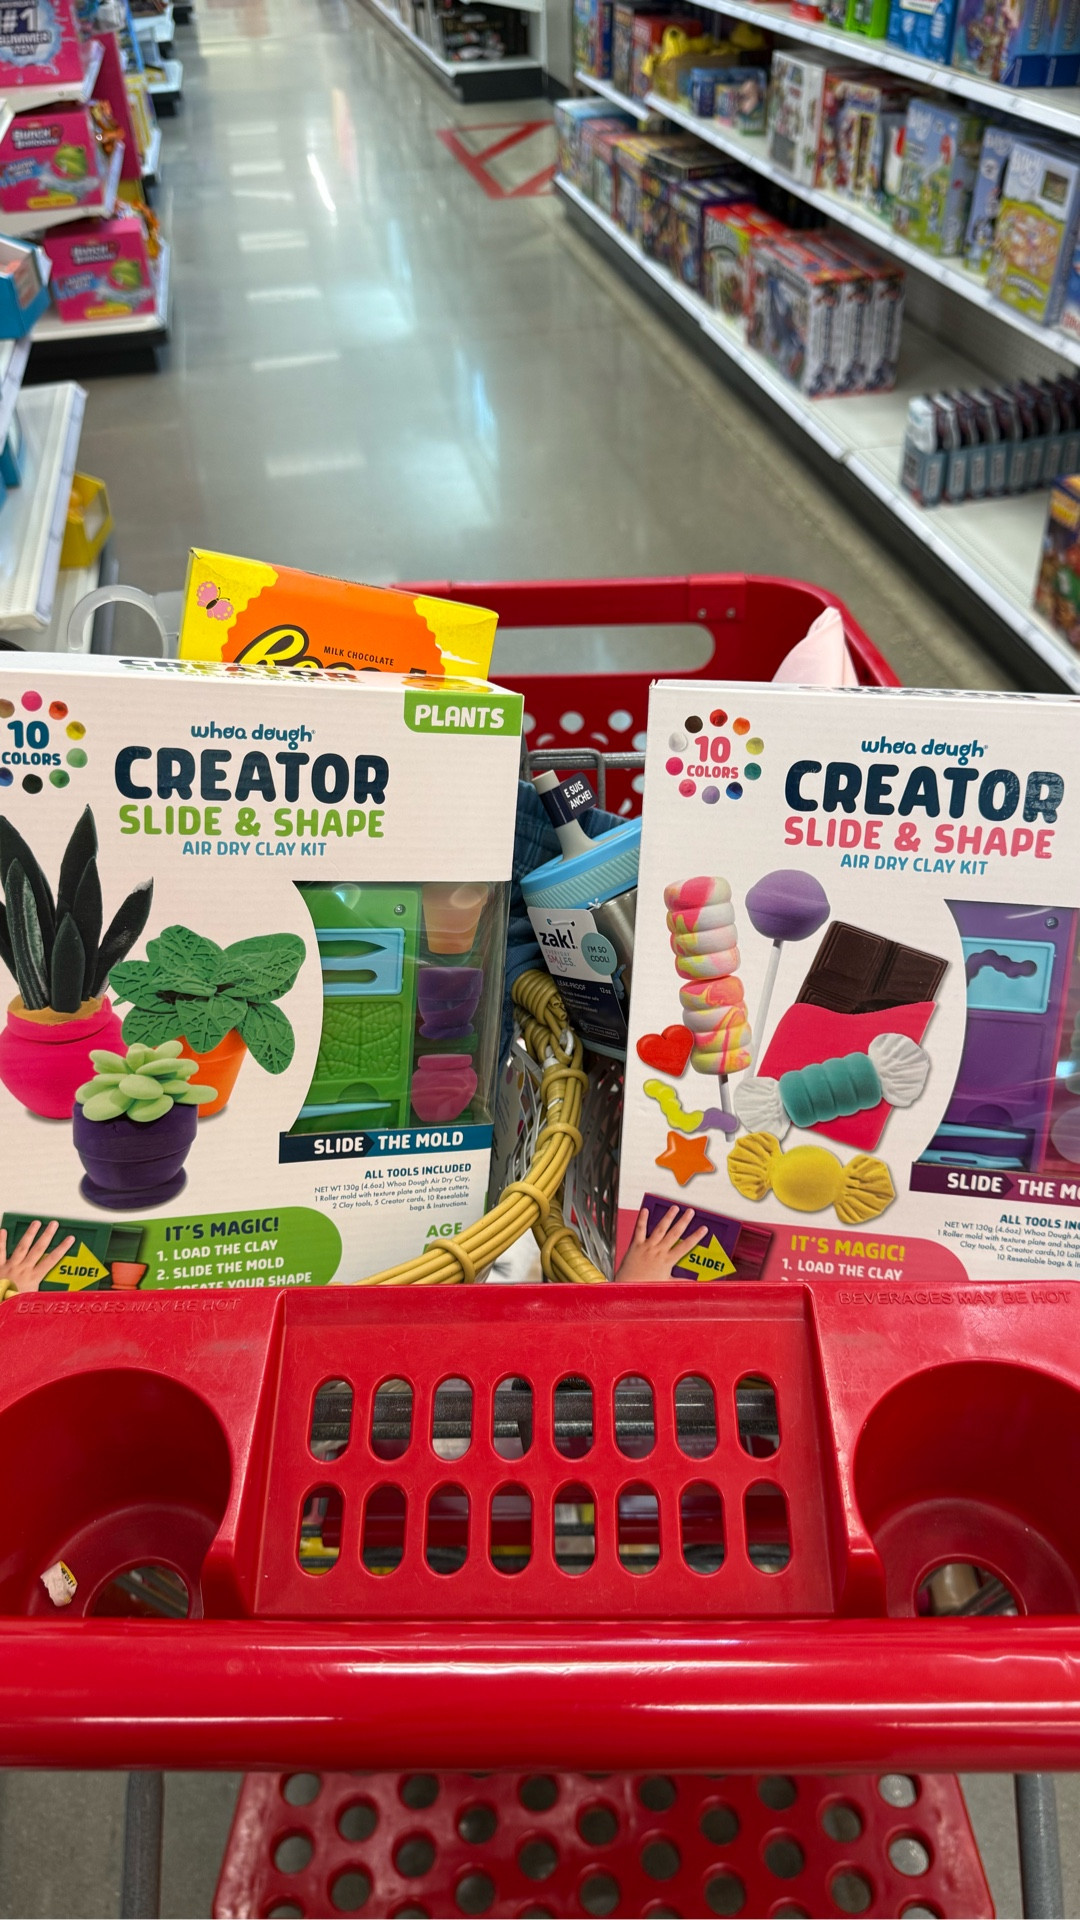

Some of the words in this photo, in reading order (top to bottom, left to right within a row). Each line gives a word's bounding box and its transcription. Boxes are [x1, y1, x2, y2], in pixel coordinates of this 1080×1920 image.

[323, 645, 344, 657] MILK
[347, 650, 395, 666] CHOCOLATE
[414, 704, 505, 729] PLANTS
[8, 720, 50, 749] 10
[191, 721, 247, 740] whoa
[694, 736, 731, 763] 10
[861, 736, 917, 755] whoa
[2, 752, 61, 766] COLORS
[115, 746, 389, 804] CREATOR
[687, 765, 739, 779] COLORS
[569, 780, 584, 795] SUIS
[784, 760, 1065, 823] CREATOR
[568, 790, 593, 810] ANCHE!
[119, 804, 222, 836] SLIDE
[235, 807, 261, 837] &
[274, 807, 385, 839] SHAPE
[784, 816, 884, 850] SLIDE
[894, 822, 921, 852] &
[934, 824, 1056, 859] SHAPE
[182, 841, 212, 855] AIR
[217, 841, 251, 856] DRY
[255, 842, 296, 856] CLAY
[301, 842, 327, 856] KIT
[840, 854, 870, 869] AIR
[874, 855, 909, 871] DRY
[913, 857, 955, 874] CLAY
[960, 860, 988, 875] KIT
[539, 929, 573, 949] zak!
[587, 945, 597, 953] I'M
[598, 946, 607, 954] SO
[314, 1137, 364, 1155] SLIDE
[378, 1134, 411, 1150] THE
[416, 1131, 463, 1148] MOLD
[365, 1169, 383, 1179] ALL
[387, 1167, 419, 1178] TOOLS
[422, 1163, 471, 1175] INCLUDED
[361, 1182, 385, 1190] (4.6oz)
[408, 1178, 428, 1187] Dough
[454, 1175, 470, 1183] Clay,
[373, 1190, 395, 1198] texture
[397, 1188, 413, 1196] plate
[415, 1186, 427, 1194] and
[429, 1186, 447, 1194] shape
[947, 1172, 1003, 1193] SLIDE
[1017, 1179, 1056, 1197] THE
[1060, 1183, 1080, 1200] M
[339, 1201, 354, 1210] Clay
[381, 1197, 405, 1205] Creator
[407, 1195, 425, 1203] cards,
[436, 1192, 469, 1200] Resealable
[409, 1204, 425, 1212] bags
[165, 1223, 204, 1242] IT'S
[210, 1217, 279, 1237] MAGIC!
[426, 1222, 462, 1238] AGE
[1000, 1214, 1021, 1225] ALL
[1025, 1216, 1061, 1229] TOOLS
[943, 1230, 963, 1238] Roller
[1001, 1236, 1026, 1244] texture
[976, 1224, 993, 1232] 130g
[995, 1226, 1021, 1235] (4.6oz)
[1024, 1228, 1046, 1237] Whoa
[1048, 1231, 1071, 1240] Dough
[156, 1251, 168, 1262] 1.
[173, 1246, 210, 1260] LOAD
[214, 1243, 241, 1256] THE
[244, 1239, 278, 1252] CLAY
[791, 1235, 829, 1254] IT'S
[834, 1239, 905, 1261] MAGIC!
[960, 1240, 976, 1249] Clay
[978, 1243, 997, 1251] tools,
[1006, 1245, 1033, 1254] Creator
[156, 1269, 169, 1280] 2.
[173, 1264, 212, 1279] SLIDE
[216, 1261, 242, 1274] THE
[246, 1257, 284, 1271] MOLD
[689, 1253, 725, 1272] SLIDE!
[782, 1258, 792, 1270] 1.
[797, 1259, 834, 1274] LOAD
[838, 1263, 864, 1277] THE
[868, 1266, 903, 1281] CLAY
[1007, 1255, 1045, 1264] Resealable
[1047, 1258, 1065, 1267] bags
[59, 1265, 99, 1278] SLIDE!
[268, 1272, 312, 1286] SHAPE
[17, 1301, 126, 1314] BEVERAGES
[130, 1301, 169, 1313] MAY
[174, 1301, 198, 1312] BE
[202, 1299, 241, 1311] HOT
[839, 1291, 950, 1304] BEVERAGES
[957, 1292, 997, 1304] MAY
[1001, 1292, 1028, 1304] BE
[1032, 1291, 1071, 1304] HOT
